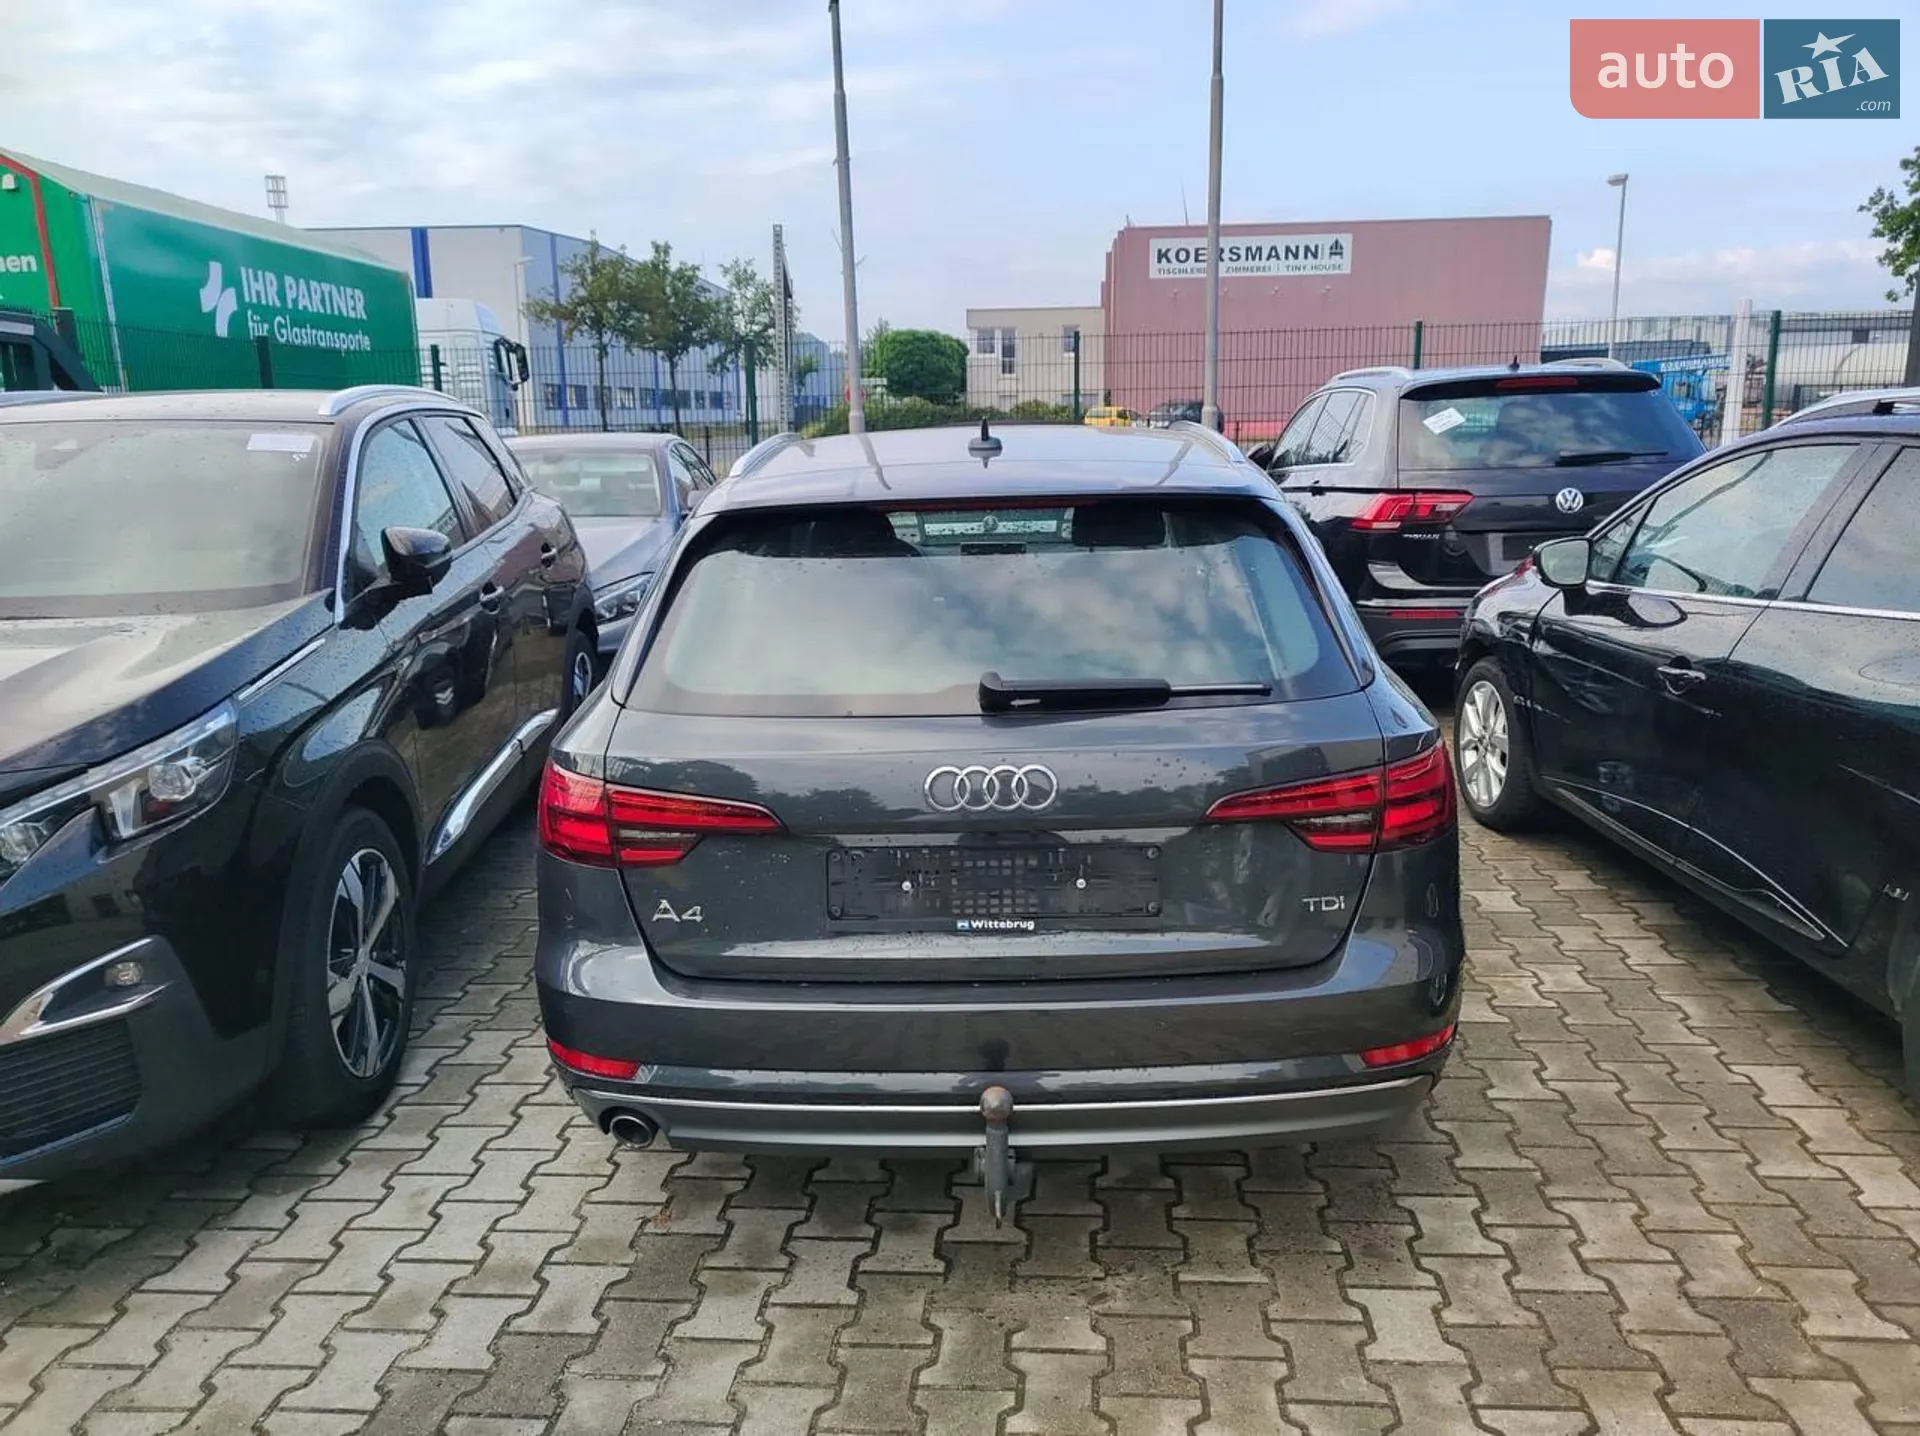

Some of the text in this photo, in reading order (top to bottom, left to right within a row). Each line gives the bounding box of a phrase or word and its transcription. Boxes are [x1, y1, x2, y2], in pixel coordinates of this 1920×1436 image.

[240, 266, 368, 321] IHR PARTNER
[247, 309, 372, 357] für Glastransporte
[651, 899, 703, 923] A4
[970, 919, 1035, 931] Wittebrug
